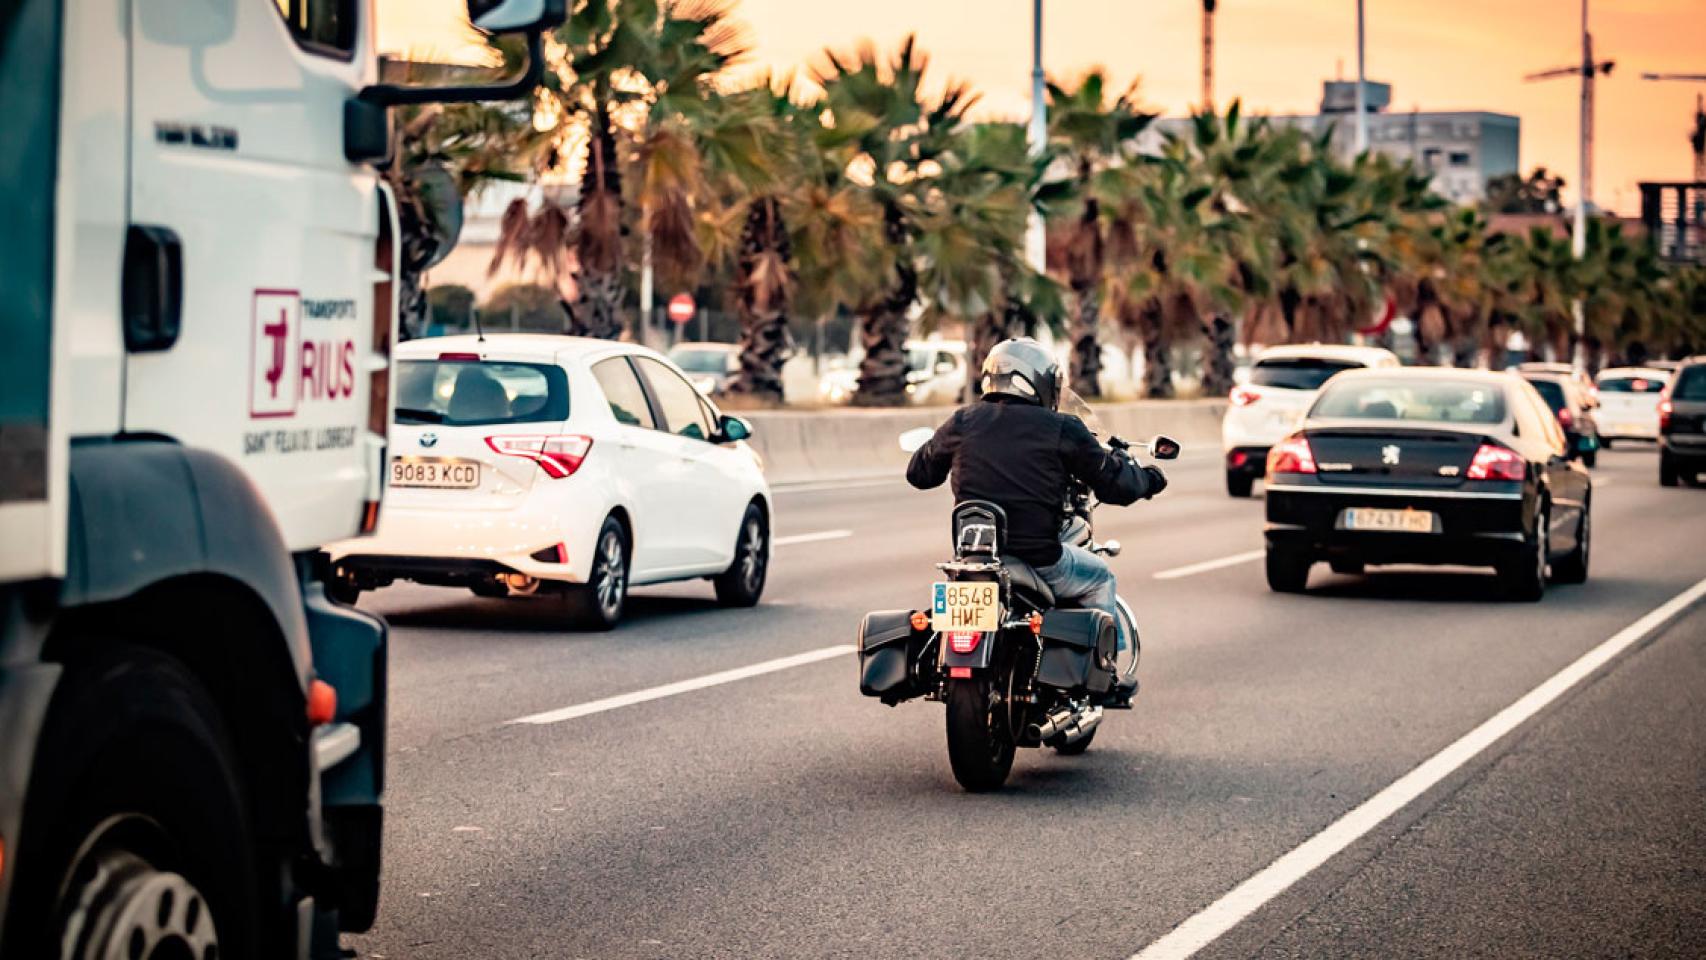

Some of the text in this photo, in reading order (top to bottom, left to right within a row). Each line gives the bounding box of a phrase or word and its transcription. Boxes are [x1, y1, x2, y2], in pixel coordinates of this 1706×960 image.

[300, 339, 355, 400] RIUS
[394, 464, 475, 483] 9083 KCD
[947, 586, 993, 607] 8548
[951, 608, 985, 627] HMF
